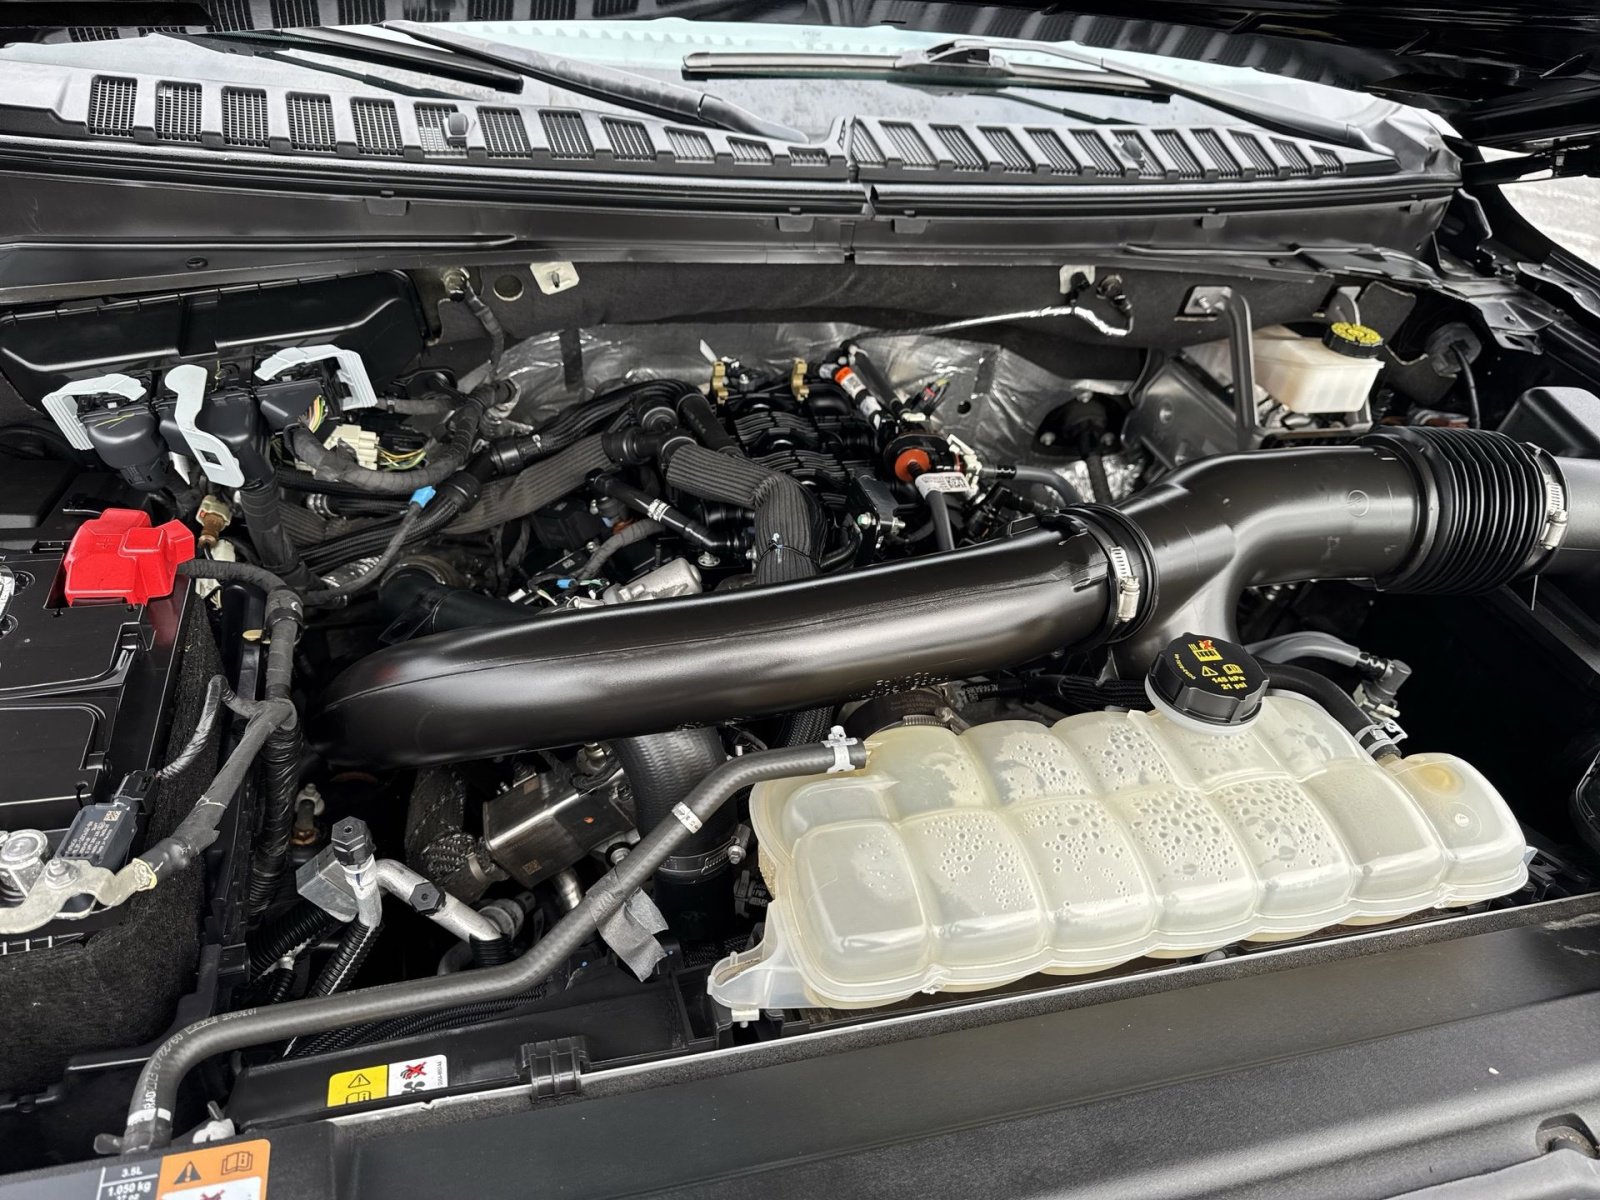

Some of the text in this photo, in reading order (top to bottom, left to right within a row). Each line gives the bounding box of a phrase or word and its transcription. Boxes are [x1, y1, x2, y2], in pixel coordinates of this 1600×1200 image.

[121, 1166, 143, 1178] 3.5L
[108, 1182, 136, 1197] 1.050
[137, 1181, 152, 1193] kg
